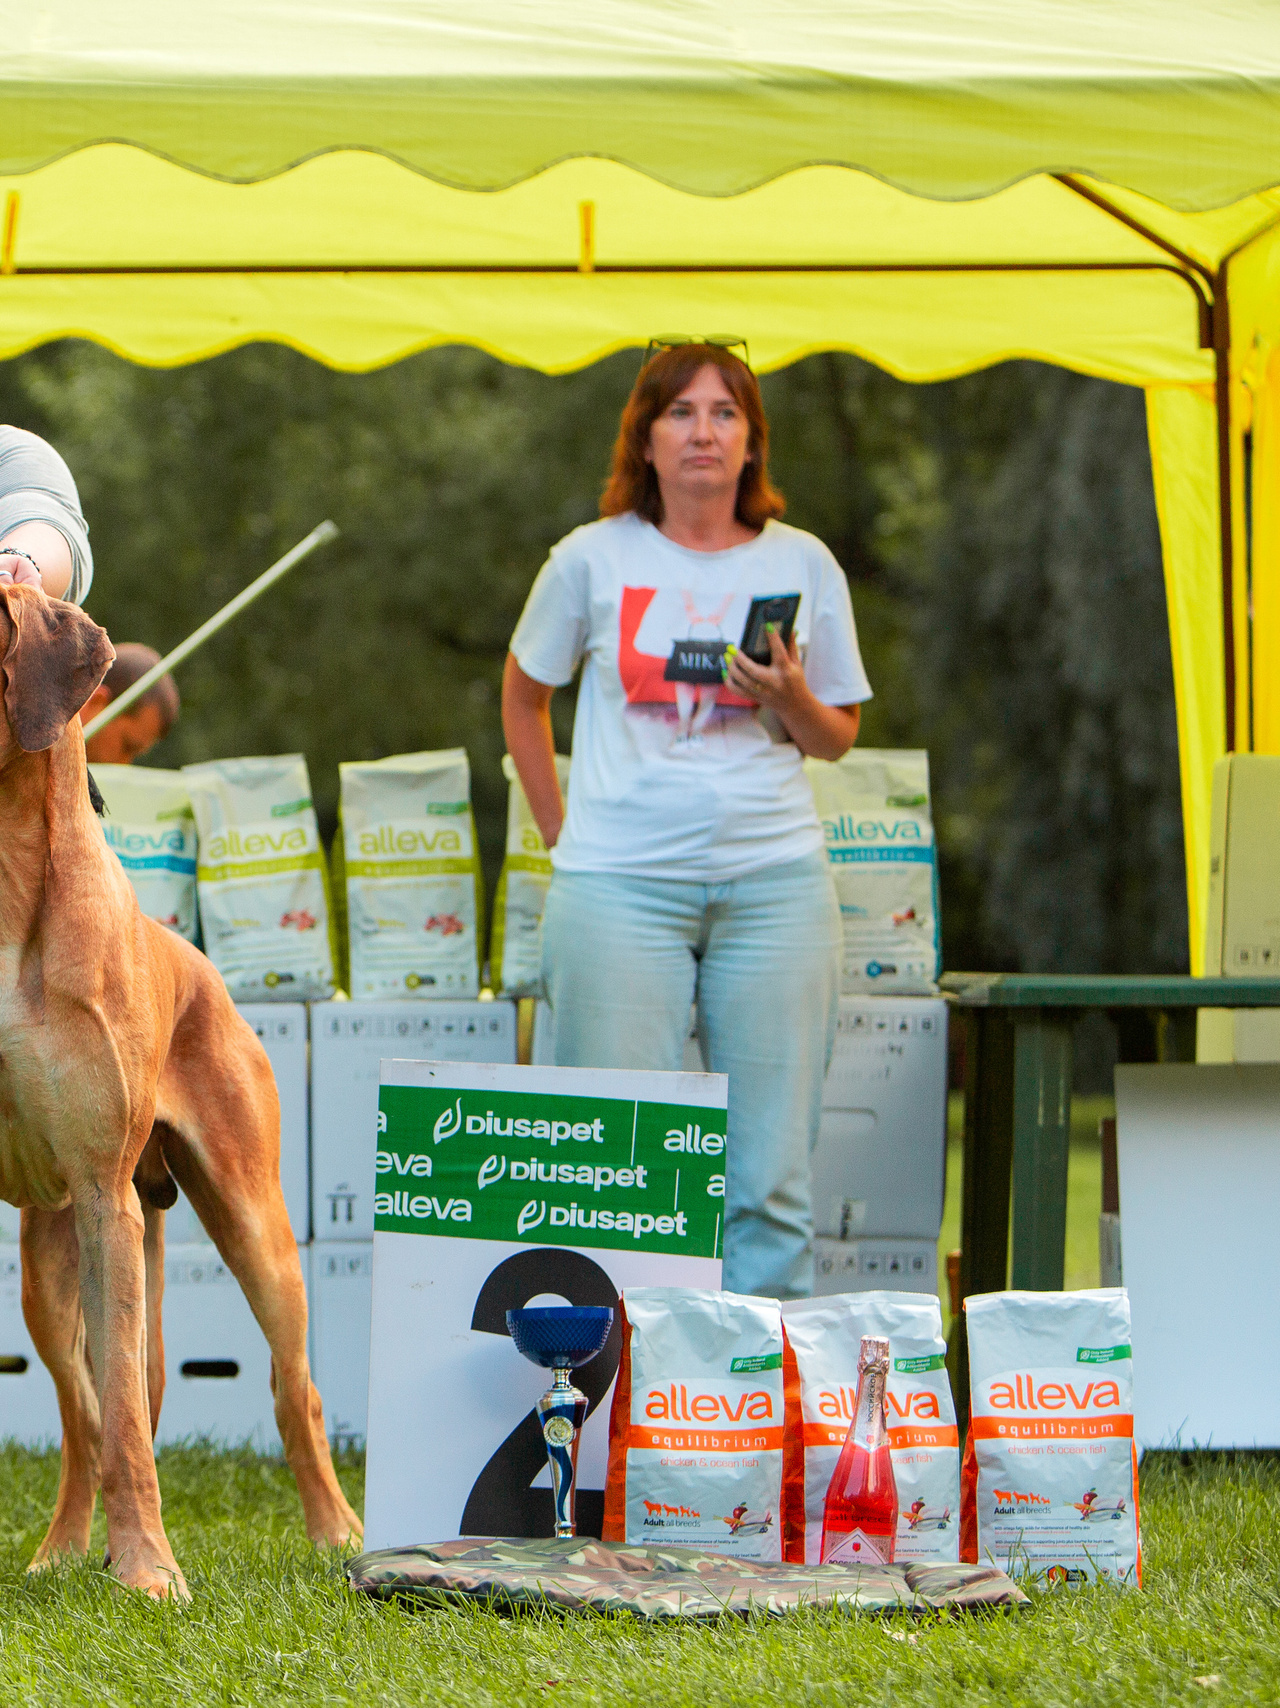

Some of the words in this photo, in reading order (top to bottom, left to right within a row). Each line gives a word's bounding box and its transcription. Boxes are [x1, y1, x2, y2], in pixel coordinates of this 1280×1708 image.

[103, 826, 185, 853] lleva
[209, 827, 308, 859] alleva
[360, 825, 461, 855] alleva
[465, 1110, 604, 1146] Diusapet
[663, 1123, 727, 1156] alle
[510, 1157, 648, 1192] Diusapet
[373, 1190, 472, 1222] alleva
[549, 1202, 688, 1239] Diusapet
[460, 1246, 624, 1539] 2
[645, 1382, 773, 1422] alleva
[818, 1385, 940, 1420] allva
[988, 1373, 1120, 1411] alleva
[652, 1434, 767, 1449] equilibrium
[998, 1423, 1114, 1438] equilibrium
[660, 1456, 697, 1467] chicken
[698, 1458, 708, 1467] &
[710, 1459, 740, 1469] ocean
[741, 1457, 760, 1468] fish
[916, 1453, 933, 1463] fish
[1007, 1445, 1044, 1455] chicken
[1046, 1446, 1055, 1455] &
[1057, 1446, 1088, 1455] ocean
[1089, 1444, 1107, 1454] fish
[643, 1518, 665, 1527] Adult
[666, 1518, 674, 1527] all
[675, 1518, 701, 1528] breeds
[994, 1506, 1016, 1515] Adult
[1016, 1506, 1025, 1515] all
[1026, 1506, 1052, 1515] breeds
